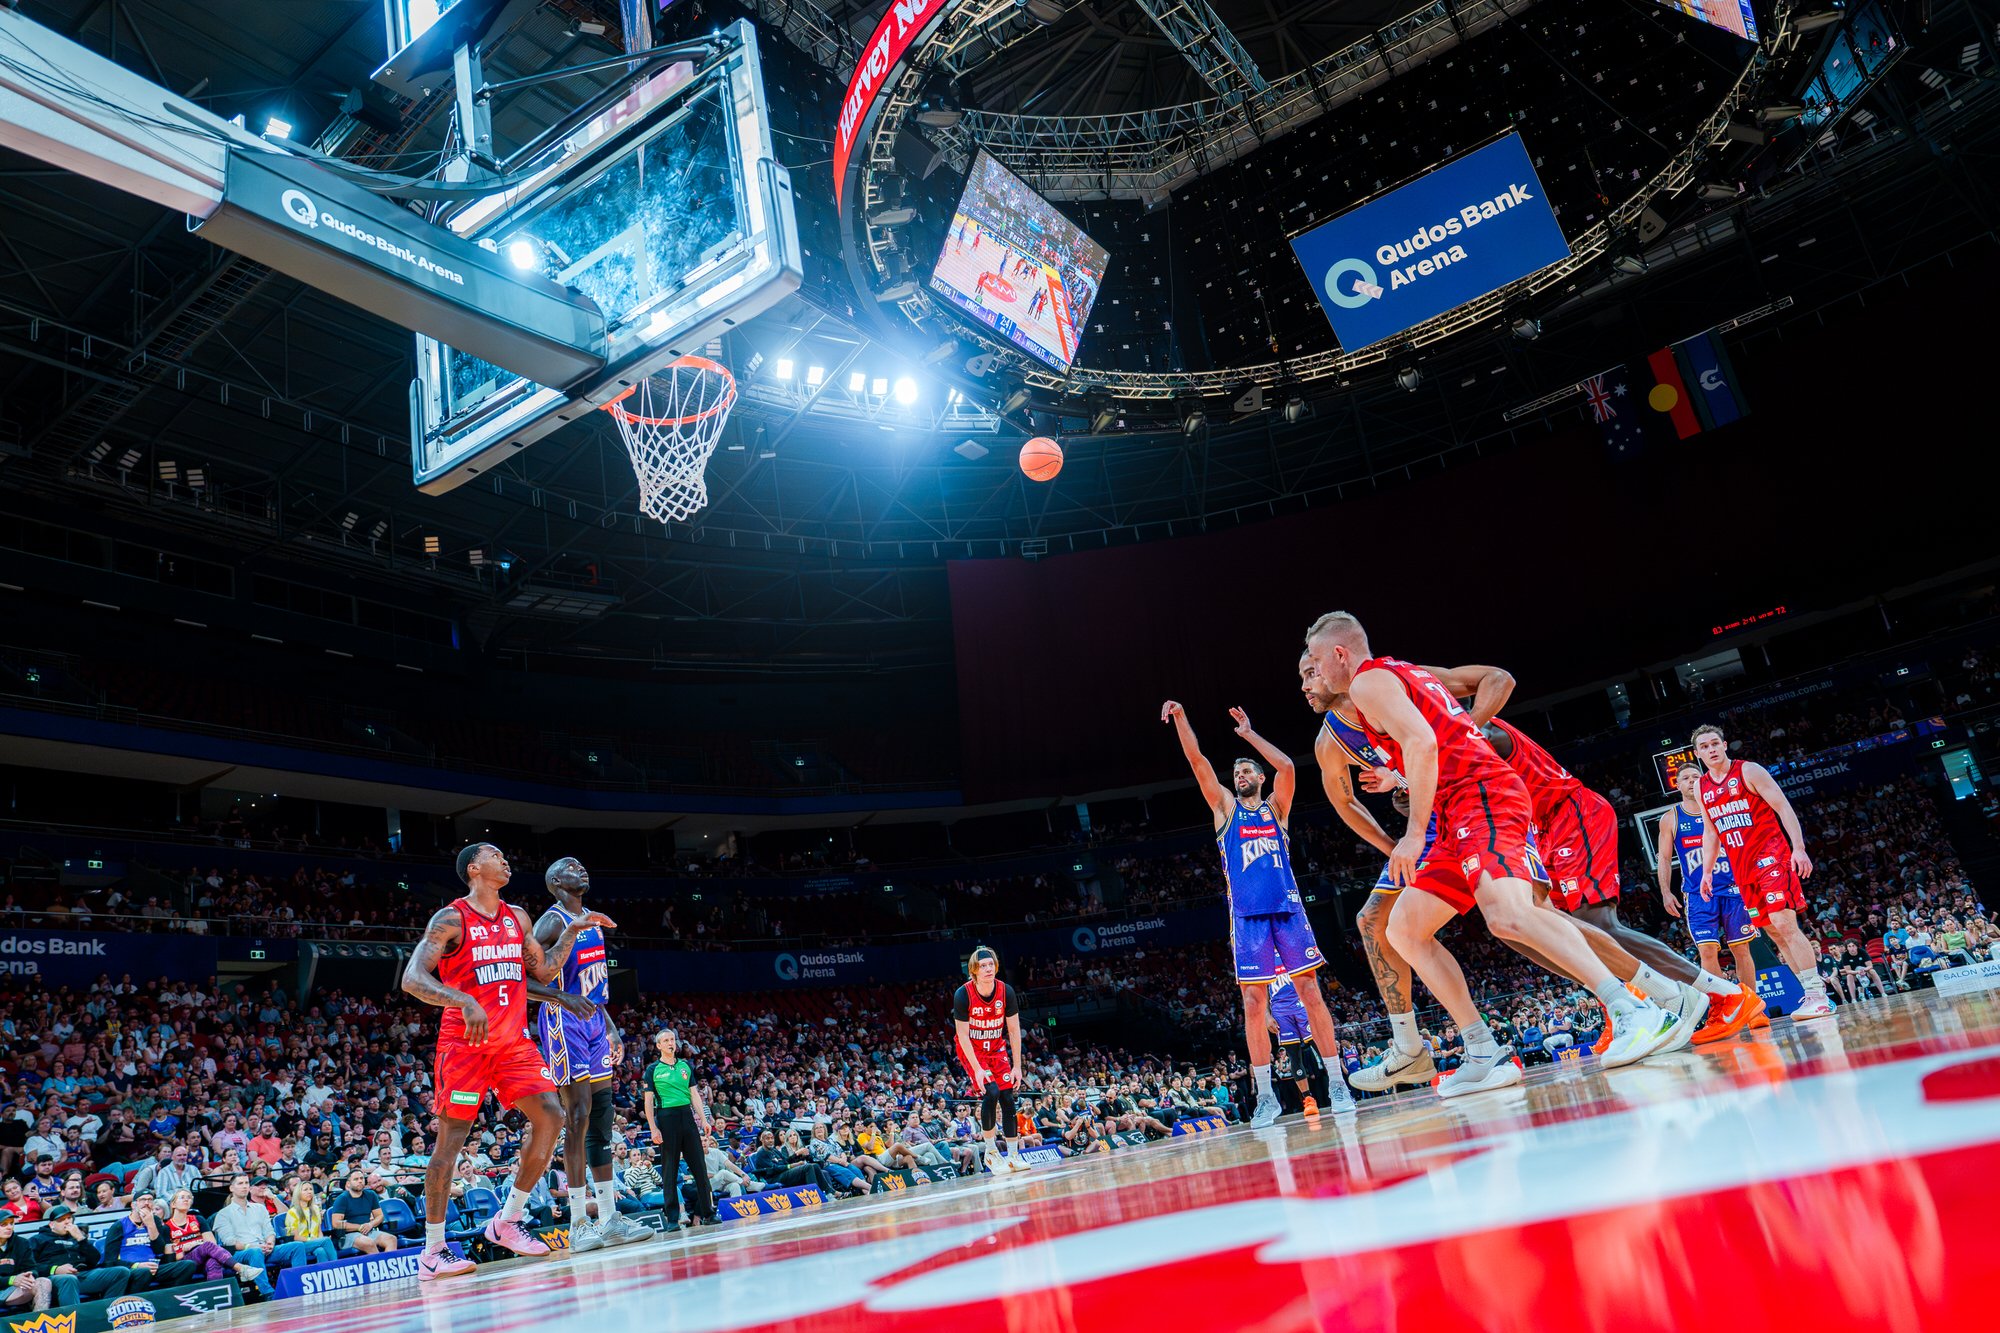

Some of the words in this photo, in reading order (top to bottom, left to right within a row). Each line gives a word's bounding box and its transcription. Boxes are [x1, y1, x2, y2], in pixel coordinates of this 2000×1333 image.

[840, 25, 891, 152] Harvey
[1376, 217, 1462, 265] Qudos
[1460, 183, 1534, 228] Bank
[320, 212, 376, 246] Qudos
[376, 236, 417, 265] Bank
[417, 256, 465, 285] Arena
[1390, 245, 1468, 290] Arena
[1667, 751, 1694, 767] 2:41
[1778, 773, 1815, 791] udos
[1812, 761, 1851, 779] Bank
[1784, 784, 1815, 800] rena
[1726, 831, 1744, 848] 40
[1712, 861, 1730, 875] 98
[1097, 923, 1136, 936] Qudos
[1136, 918, 1166, 931] Bank
[48, 938, 107, 955] Bank
[1101, 935, 1136, 948] Arena
[471, 943, 522, 962] HOLMAN
[800, 953, 836, 966] Qudos
[836, 951, 865, 964] Bank
[802, 967, 836, 978] Arena
[1943, 968, 1978, 981] SALON
[499, 984, 510, 1006] 5
[1759, 990, 1786, 999] OSTPLUS
[982, 1041, 991, 1052] 9
[301, 1262, 365, 1294] SYDNEY
[107, 1301, 155, 1322] HOOPS
[119, 1312, 146, 1322] CAPITAL
